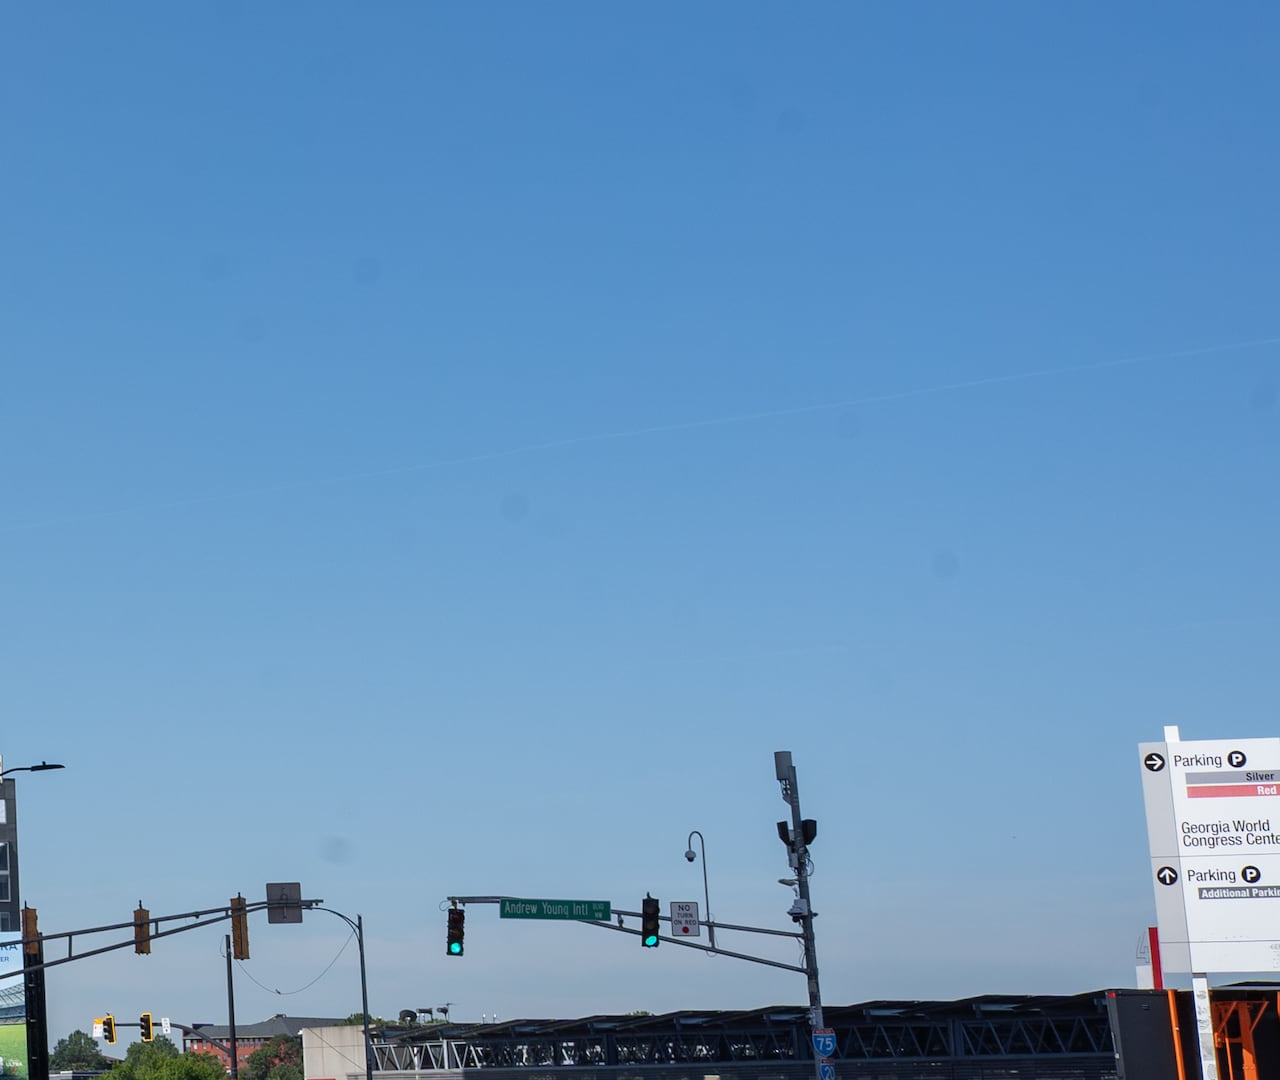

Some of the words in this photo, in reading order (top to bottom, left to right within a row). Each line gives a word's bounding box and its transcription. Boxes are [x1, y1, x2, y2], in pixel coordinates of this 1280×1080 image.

[1173, 753, 1223, 768] Parking
[1245, 771, 1275, 782] Silver
[1257, 785, 1277, 795] Red
[1181, 820, 1231, 836] Georgia
[1232, 819, 1270, 832] World
[1183, 834, 1242, 849] Congress
[1187, 868, 1237, 883] Parking
[1201, 888, 1250, 898] Additional
[504, 901, 538, 915] Andrew
[542, 902, 569, 919] Young
[572, 902, 589, 915] Intl
[678, 904, 691, 912] NO
[816, 1037, 834, 1051] 75
